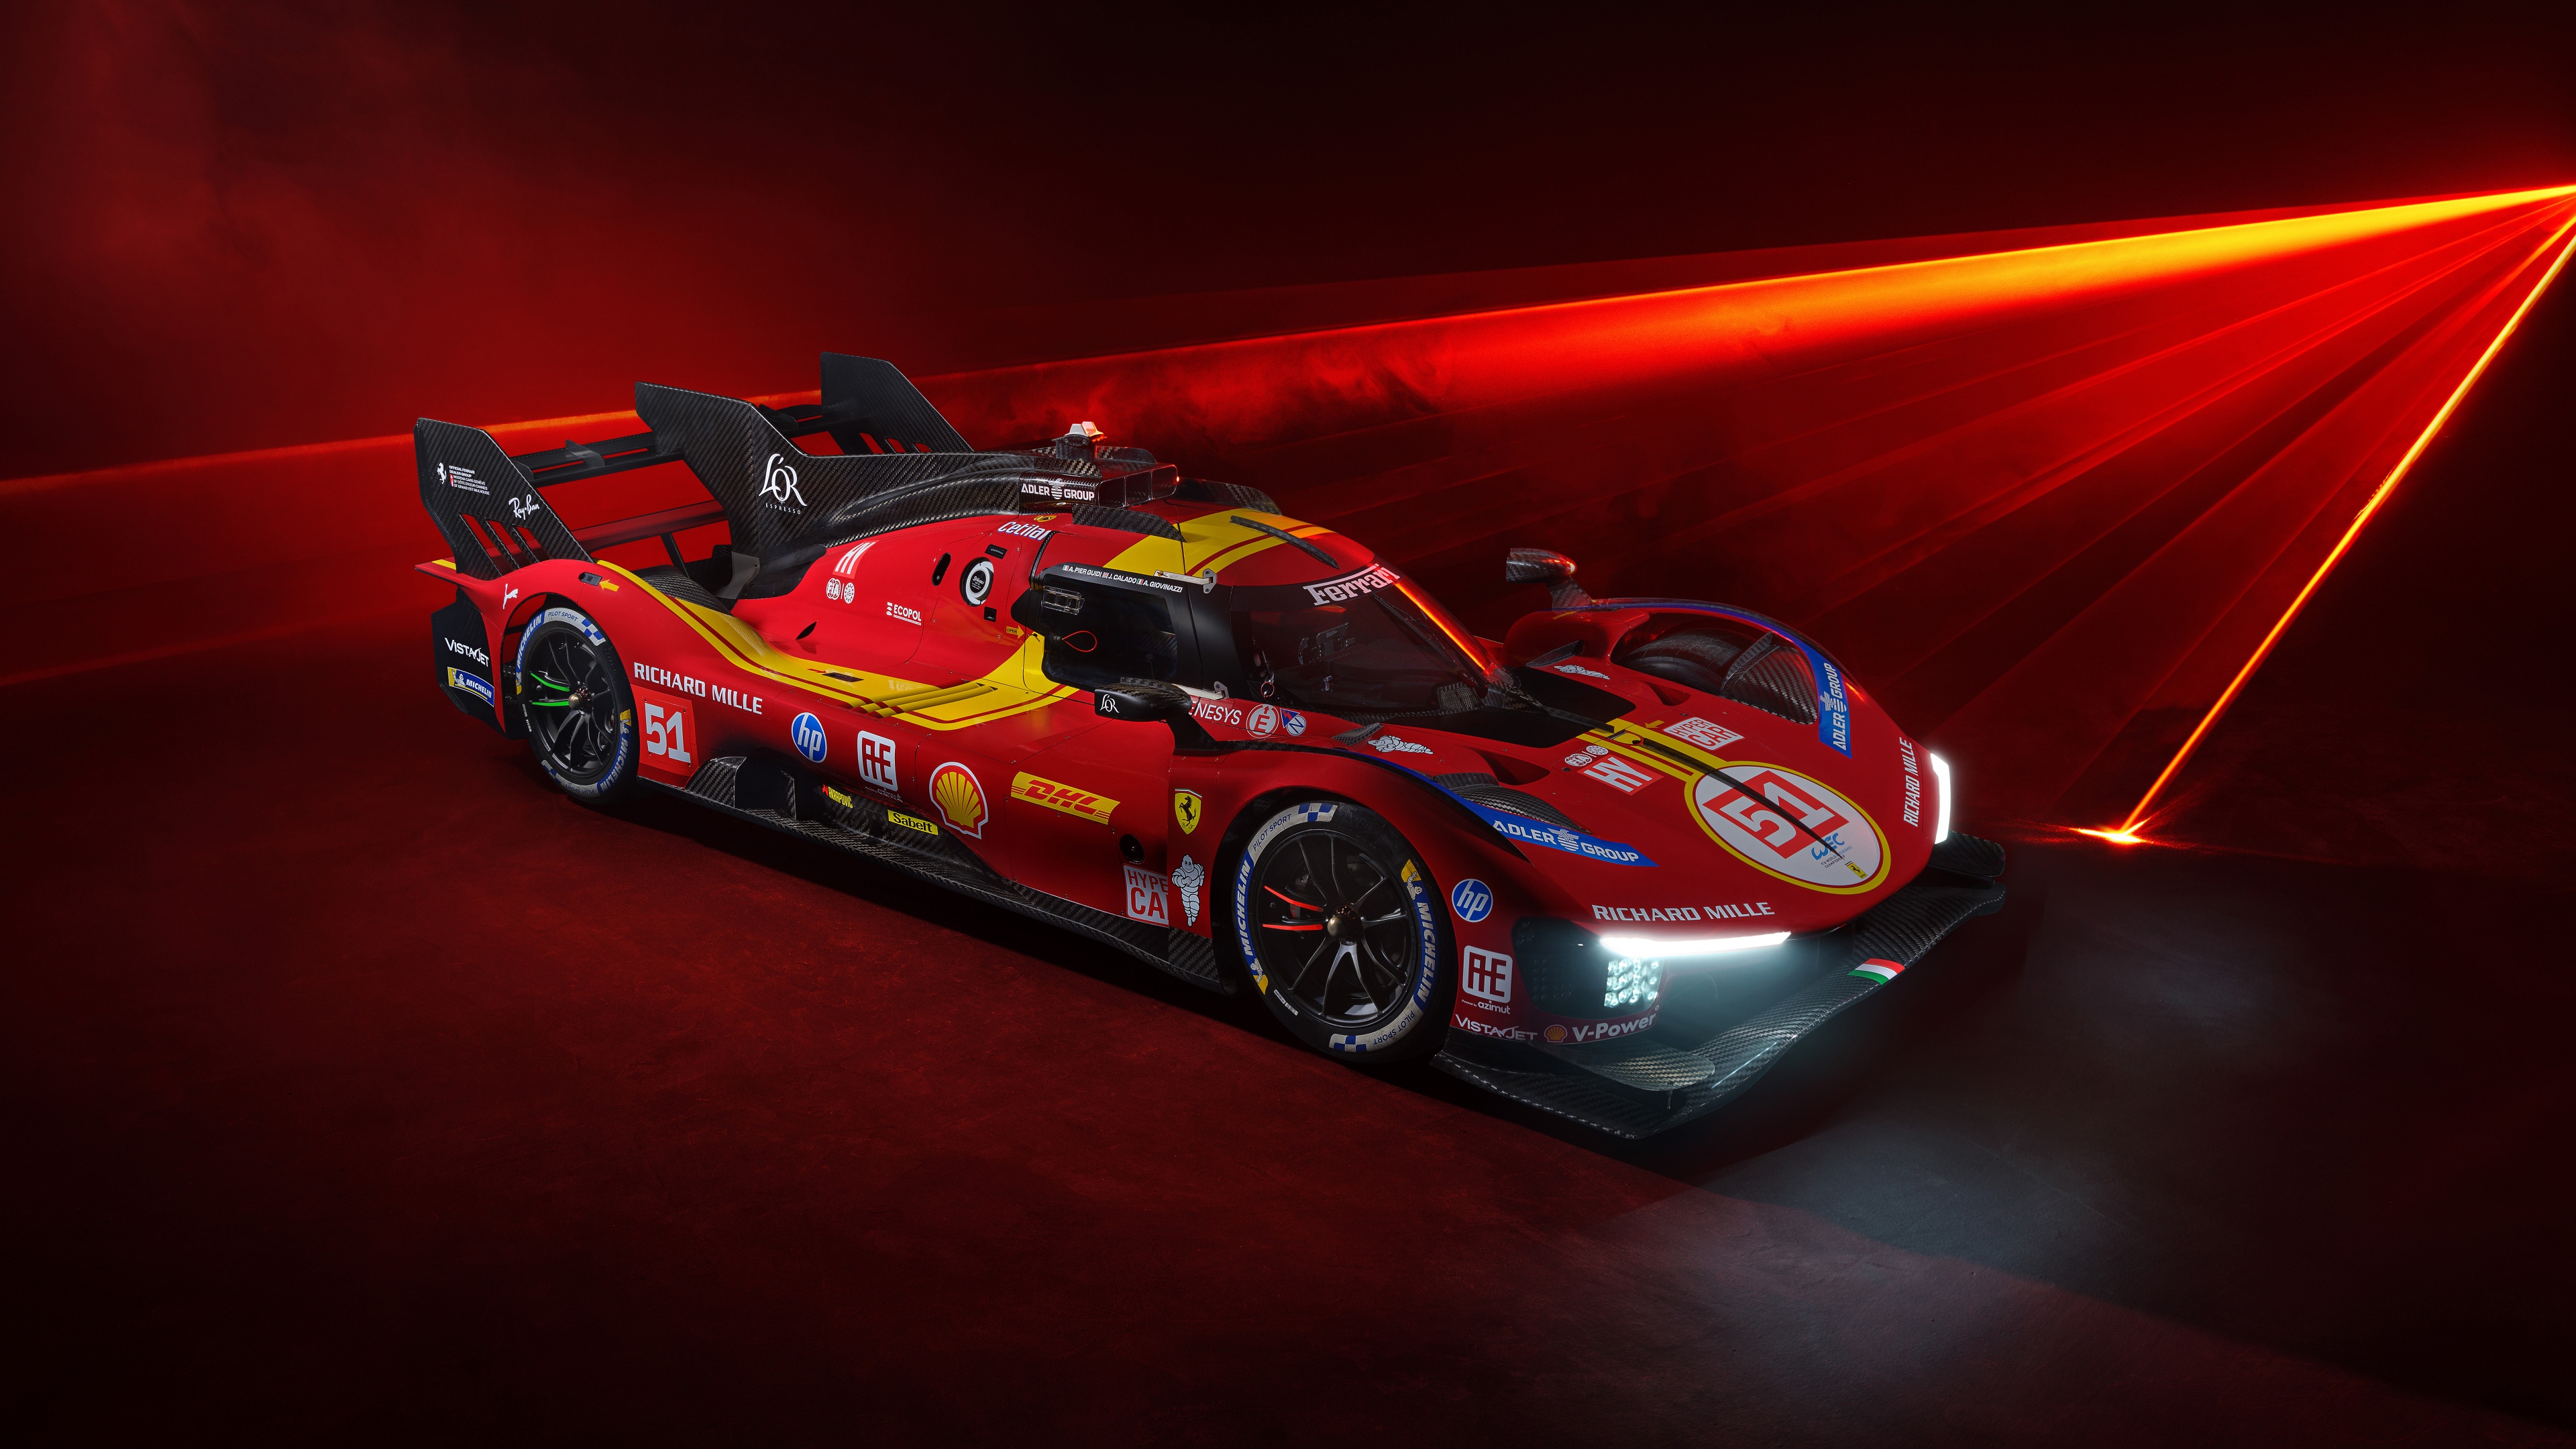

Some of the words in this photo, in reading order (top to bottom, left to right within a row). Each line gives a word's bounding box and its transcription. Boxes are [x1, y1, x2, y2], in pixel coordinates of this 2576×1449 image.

[1021, 483, 1051, 496] ADLER
[1063, 488, 1095, 501] GROUP
[765, 502, 801, 515] ESPRESSO
[998, 521, 1052, 541] Cetilar
[1074, 567, 1087, 575] PIER
[1087, 569, 1102, 578] GUIDI
[1113, 574, 1137, 584] CALADO
[1149, 581, 1183, 593] GIOVINAZZI
[1303, 563, 1401, 606] Ferrari
[561, 612, 578, 622] SPORT
[893, 604, 922, 622] ECOPOL
[517, 614, 542, 669] MICHELIN
[466, 678, 492, 698] MICHELIN
[633, 661, 706, 698] RICHARD
[712, 684, 763, 715] MILLE
[1823, 662, 1843, 699] GROUP
[645, 702, 692, 763] 51
[798, 714, 822, 761] hp
[1670, 719, 1711, 737] HYPER
[1687, 727, 1738, 747] CAR
[1833, 712, 1847, 751] ADLER
[600, 737, 629, 792] MICHELIN
[1899, 737, 1919, 776] MILLE
[566, 784, 581, 794] SPORT
[1583, 756, 1653, 793] HY
[1024, 779, 1100, 815] DHL
[1903, 775, 1921, 828] RICHARD
[893, 812, 933, 833] Sabelt
[1719, 781, 1836, 848] 51
[1252, 829, 1269, 851] PILOT
[1269, 814, 1292, 833] SPORT
[1493, 820, 1557, 845] ADLER
[1580, 841, 1639, 862] GROUP
[1236, 859, 1254, 956] MICHELIN
[1456, 880, 1489, 920] hp
[1591, 904, 1701, 922] RICHARD
[1703, 902, 1776, 920] MILLE
[1417, 902, 1436, 1003] MICHELIN
[1397, 1010, 1415, 1032] PILOT
[1478, 1000, 1511, 1015] azimut
[1373, 1029, 1397, 1045] SPORT
[1455, 1014, 1538, 1040] VISTAJET
[1572, 1013, 1656, 1042] V-Power
